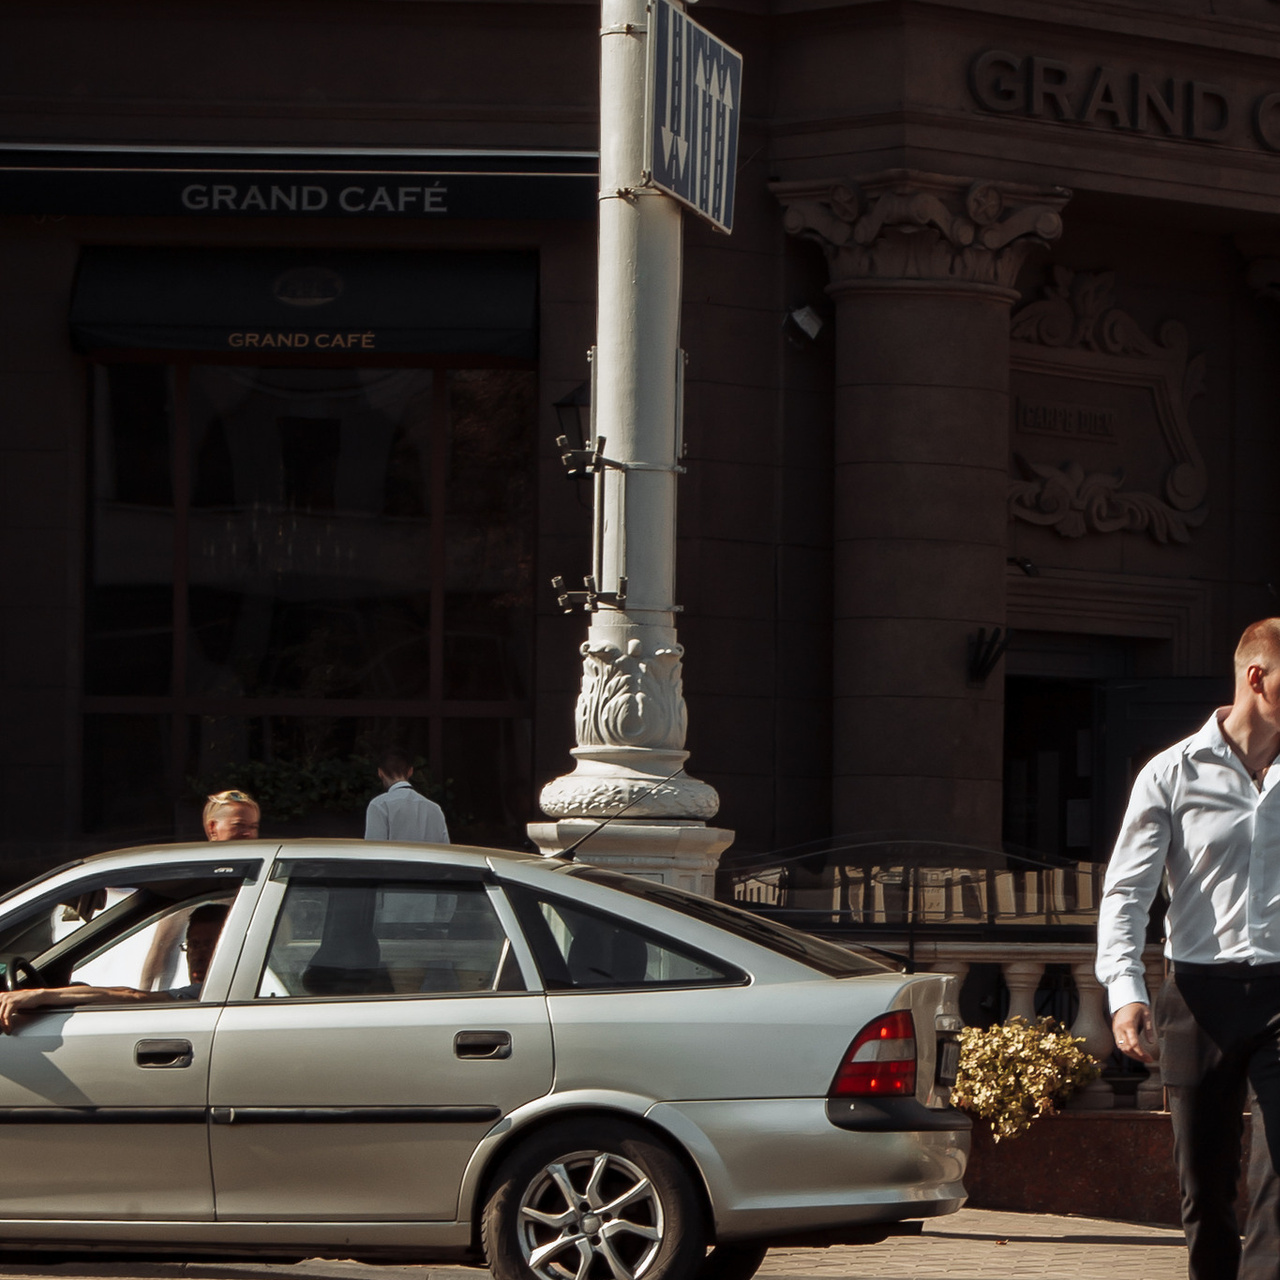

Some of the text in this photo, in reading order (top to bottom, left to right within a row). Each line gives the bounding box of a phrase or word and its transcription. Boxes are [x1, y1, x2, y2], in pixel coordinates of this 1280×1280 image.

[969, 50, 1230, 143] GRAND
[181, 181, 448, 213] GRAND CAFÉ
[228, 331, 375, 349] GRAND CAFÉ
